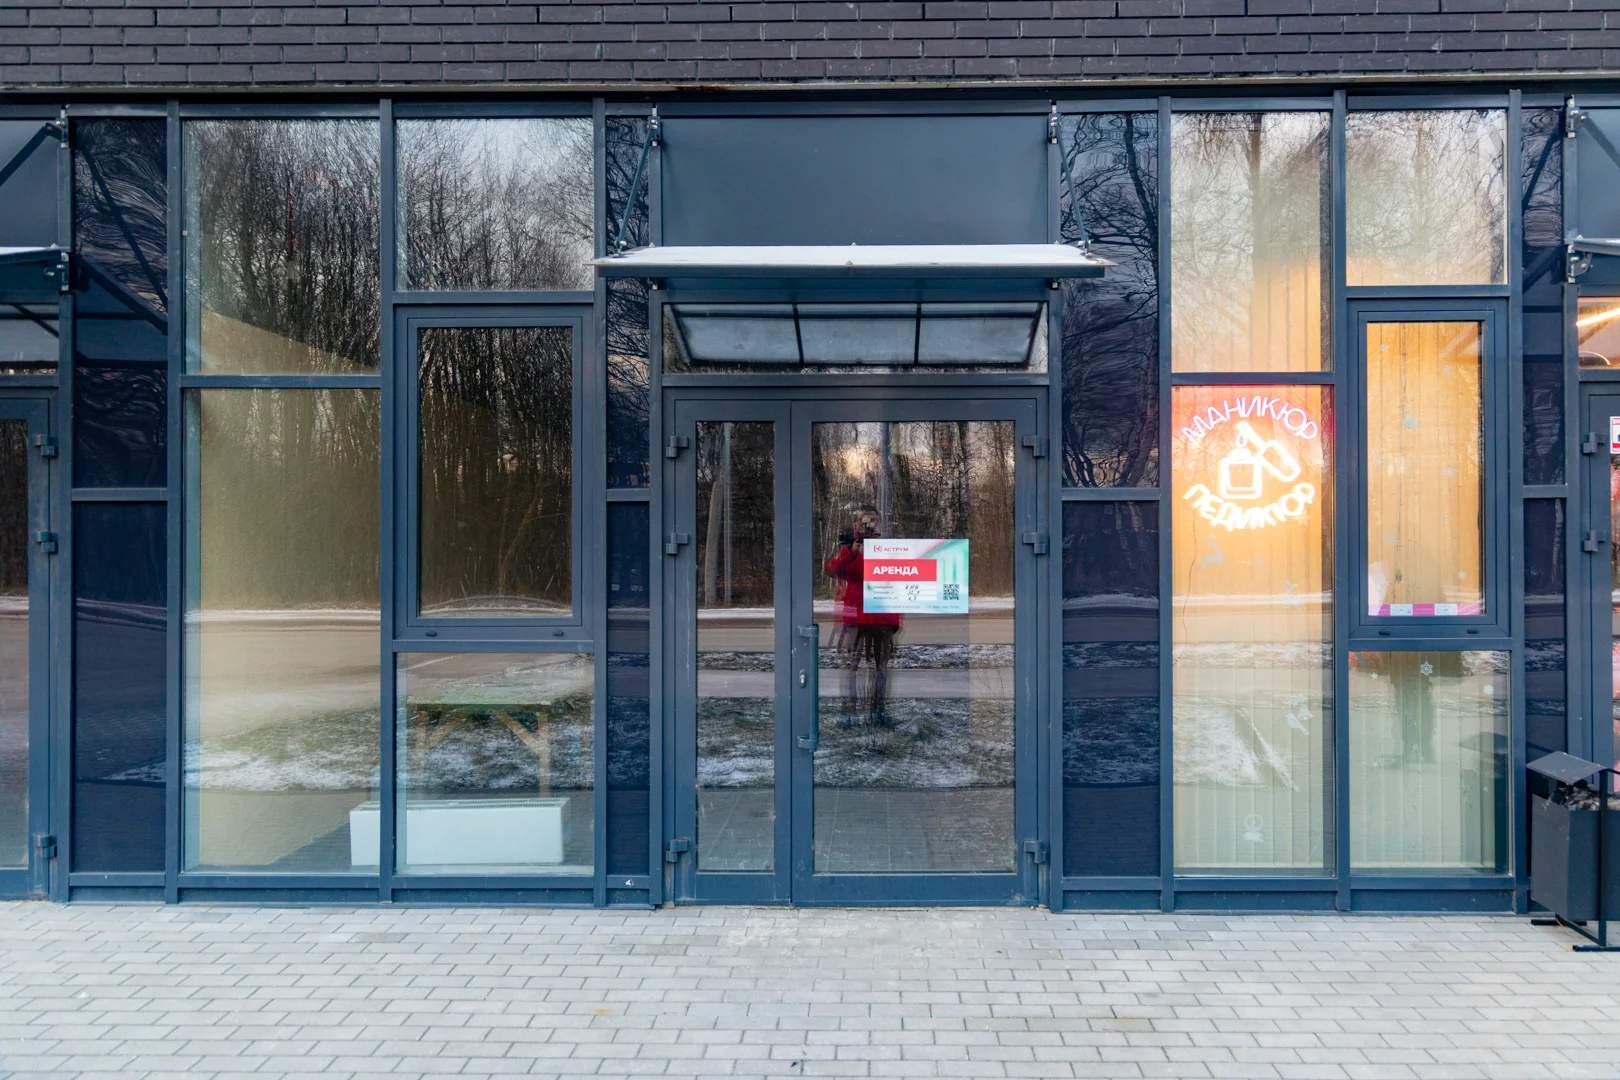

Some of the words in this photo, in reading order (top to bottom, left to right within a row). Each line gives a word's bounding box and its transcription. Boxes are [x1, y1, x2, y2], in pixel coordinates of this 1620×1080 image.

[1181, 395, 1318, 442] МАНИКЮР
[1183, 482, 1316, 531] ПЕДИКЮР
[873, 566, 918, 576] АРЕНДА
